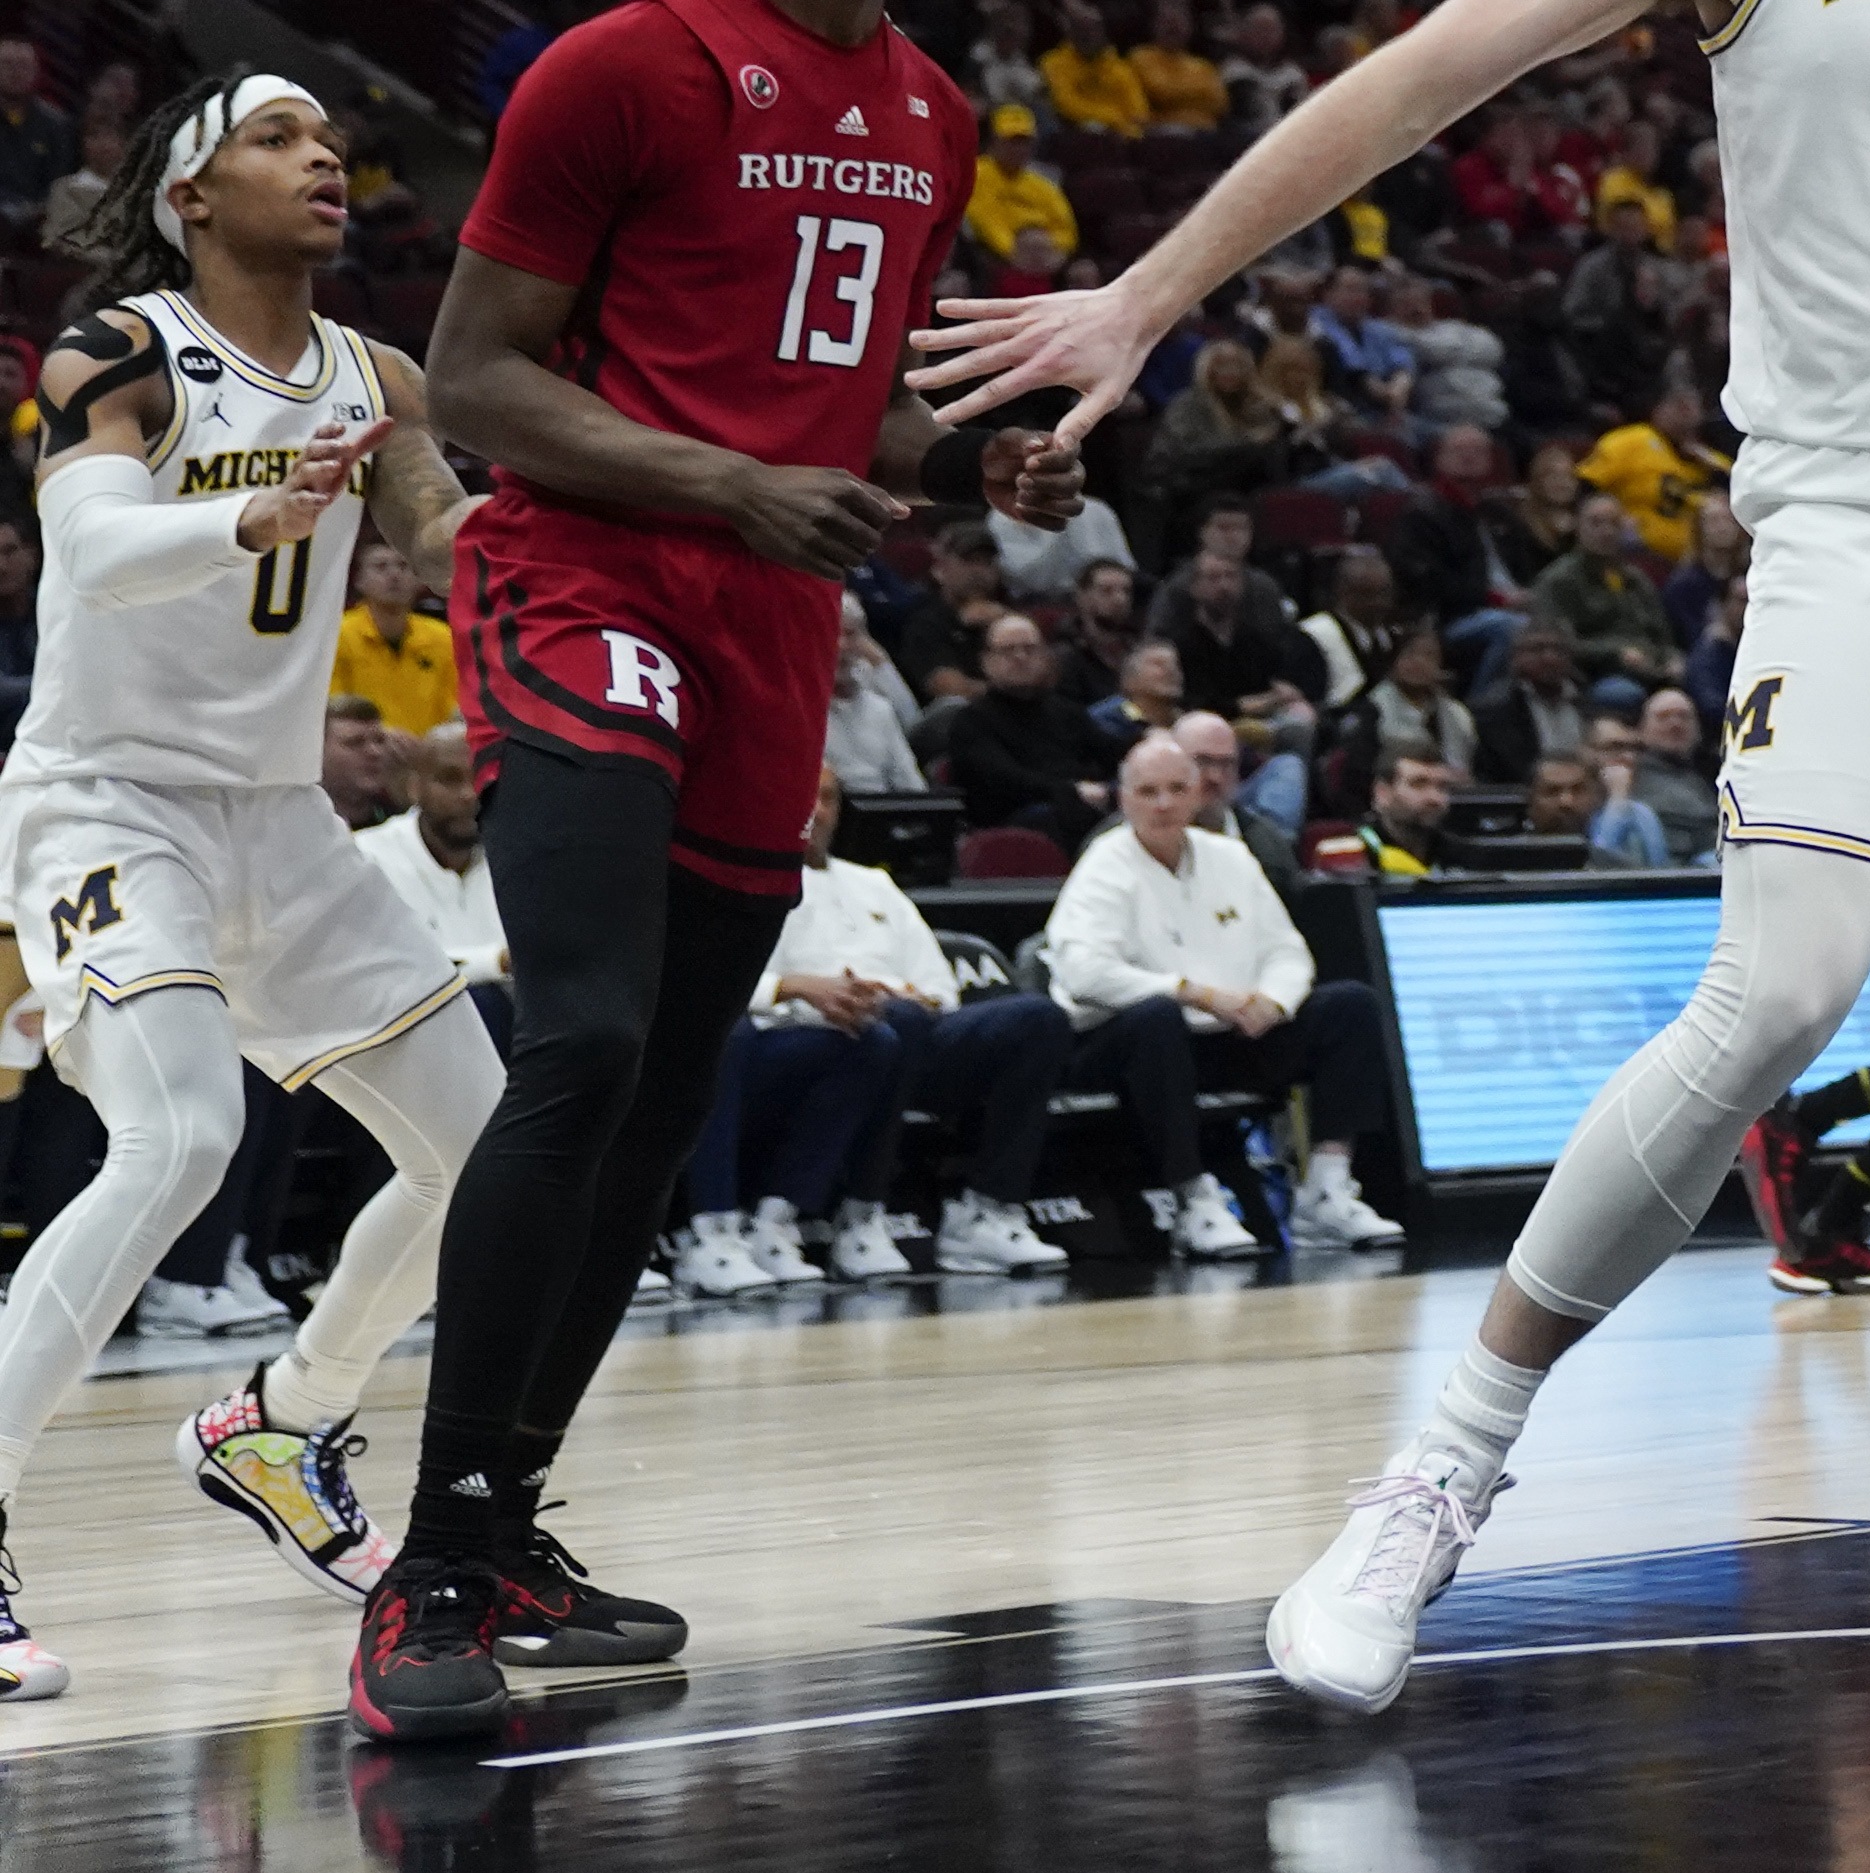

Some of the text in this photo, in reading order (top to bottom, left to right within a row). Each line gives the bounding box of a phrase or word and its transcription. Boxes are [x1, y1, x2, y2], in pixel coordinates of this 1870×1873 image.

[737, 153, 934, 206] RUTGERS
[777, 215, 885, 369] 13
[249, 534, 314, 637] 0
[600, 628, 682, 729] R
[1721, 675, 1784, 755] M
[50, 865, 125, 964] M
